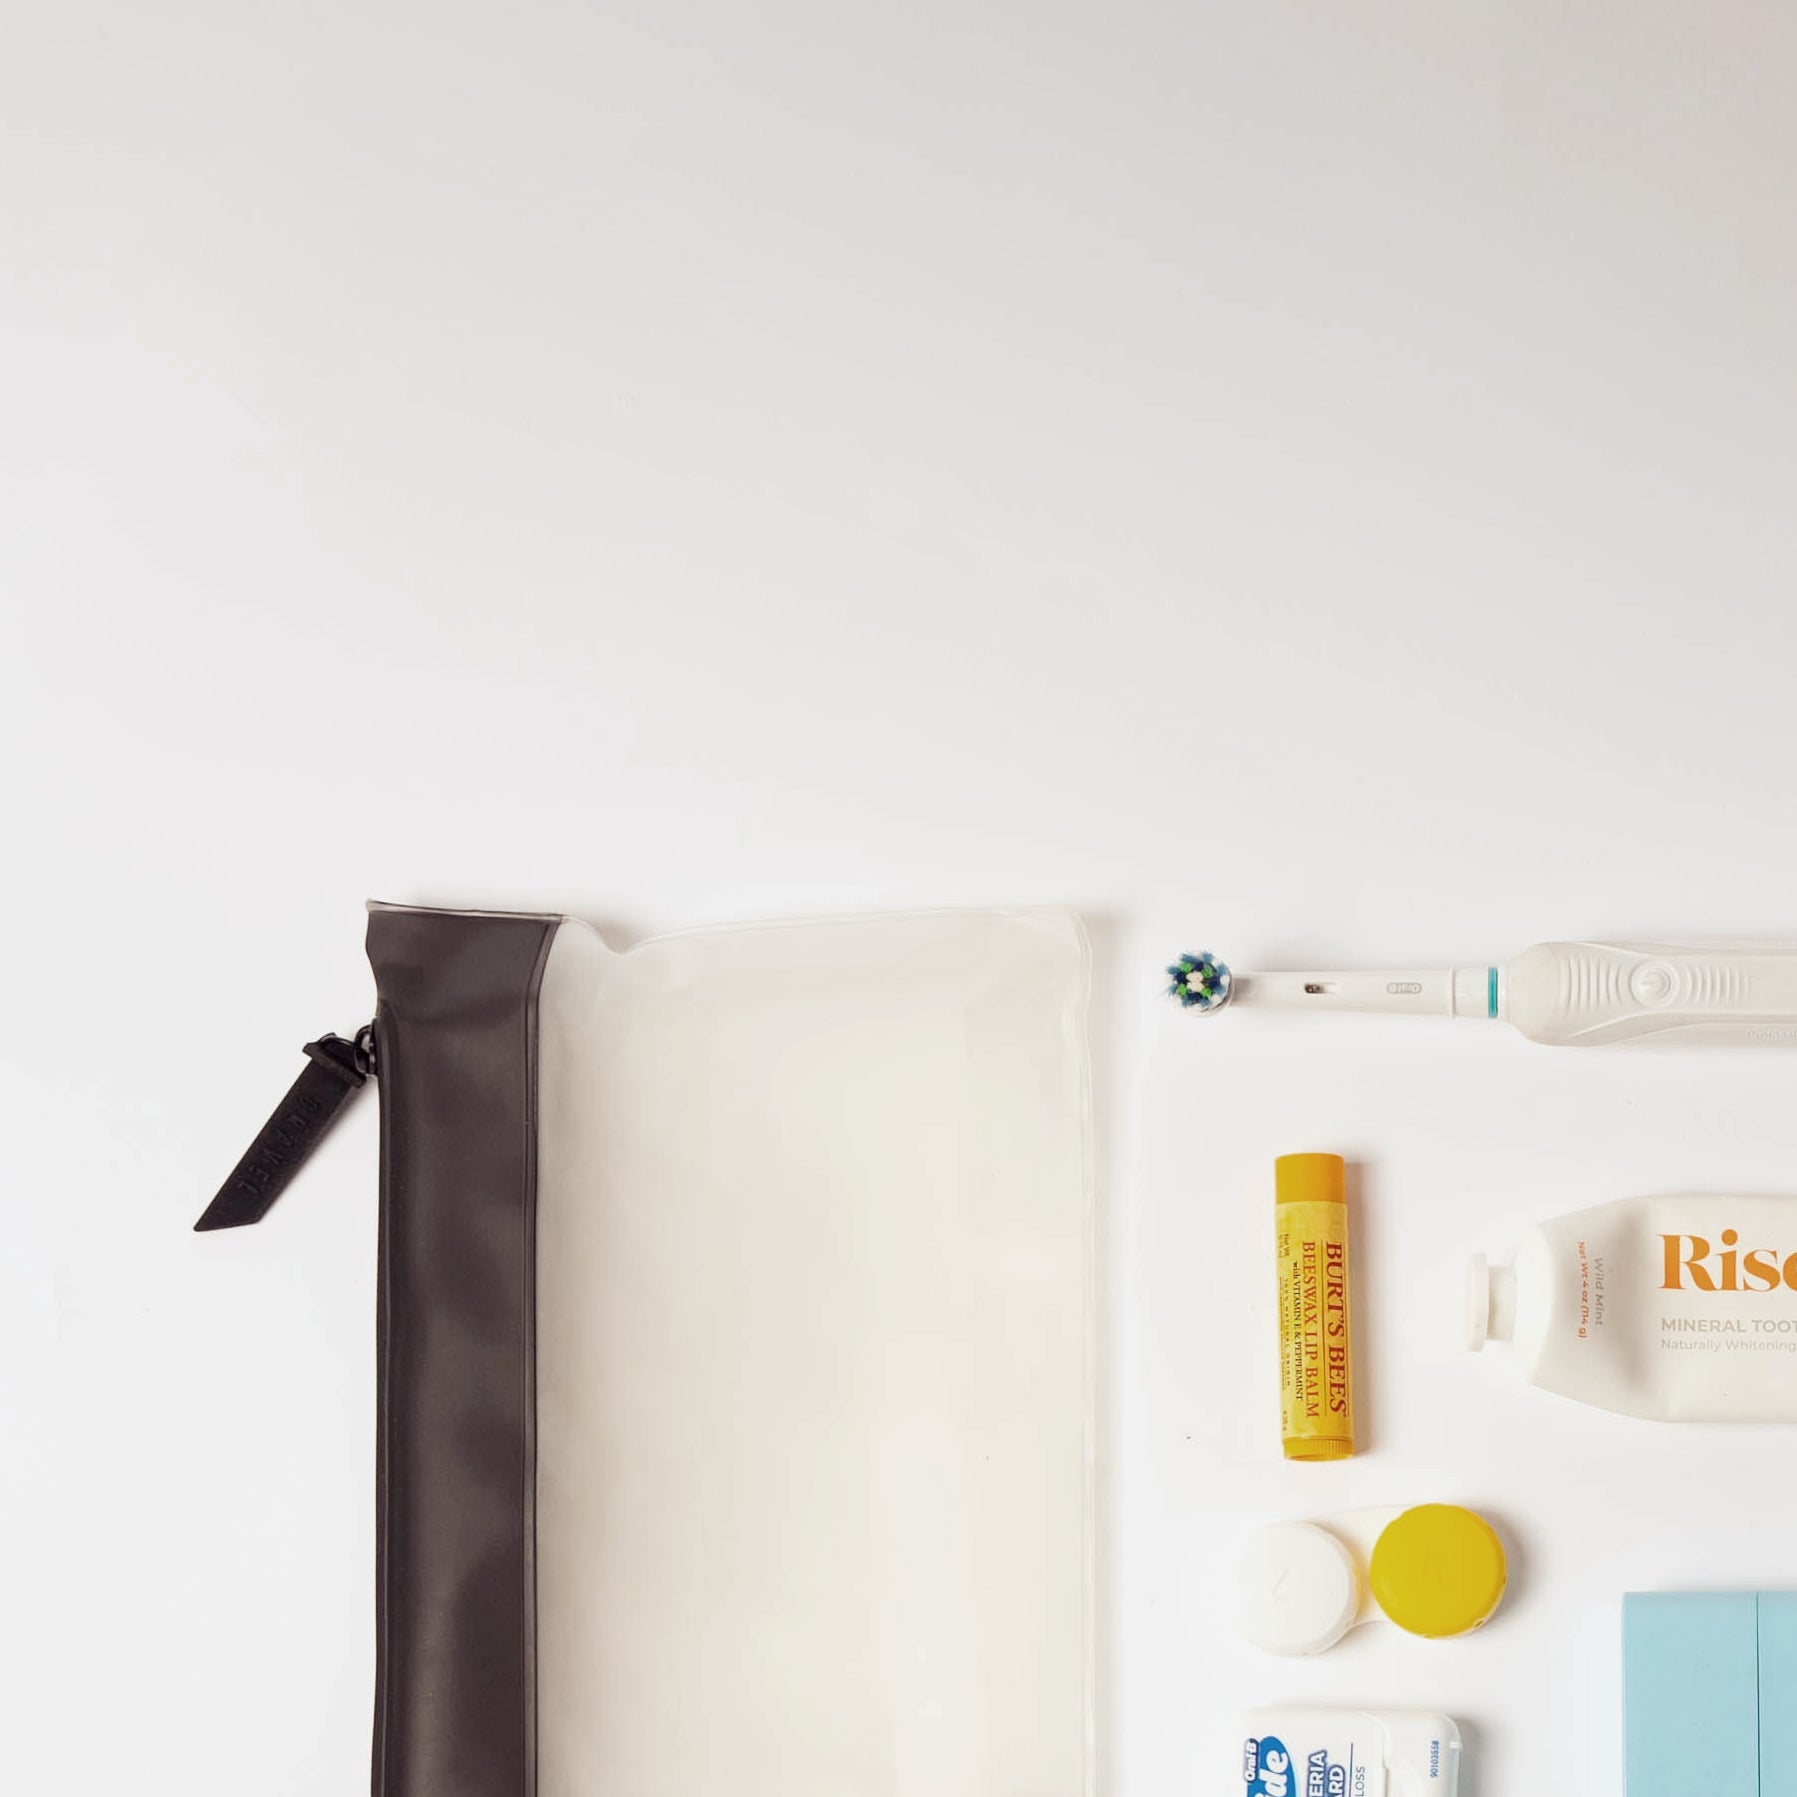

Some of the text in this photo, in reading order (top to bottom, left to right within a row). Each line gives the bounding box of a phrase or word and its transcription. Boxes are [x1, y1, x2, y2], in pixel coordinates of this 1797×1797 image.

[1577, 1241, 1588, 1260] Net
[1292, 1260, 1301, 1280] with
[1581, 1280, 1590, 1288] 4
[1594, 1257, 1605, 1326] Wild Mint
[1293, 1280, 1302, 1323] VITAMIN
[1581, 1290, 1590, 1303] oz
[1294, 1330, 1302, 1340] &
[1302, 1240, 1320, 1418] BEESWAX LIP BALM
[1325, 1240, 1347, 1413] BURT'S BEES
[1661, 1317, 1746, 1334] MINERAL
[1661, 1338, 1722, 1353] Naturally
[1724, 1338, 1797, 1353] Whitening
[1294, 1341, 1304, 1401] PEPPERMINT
